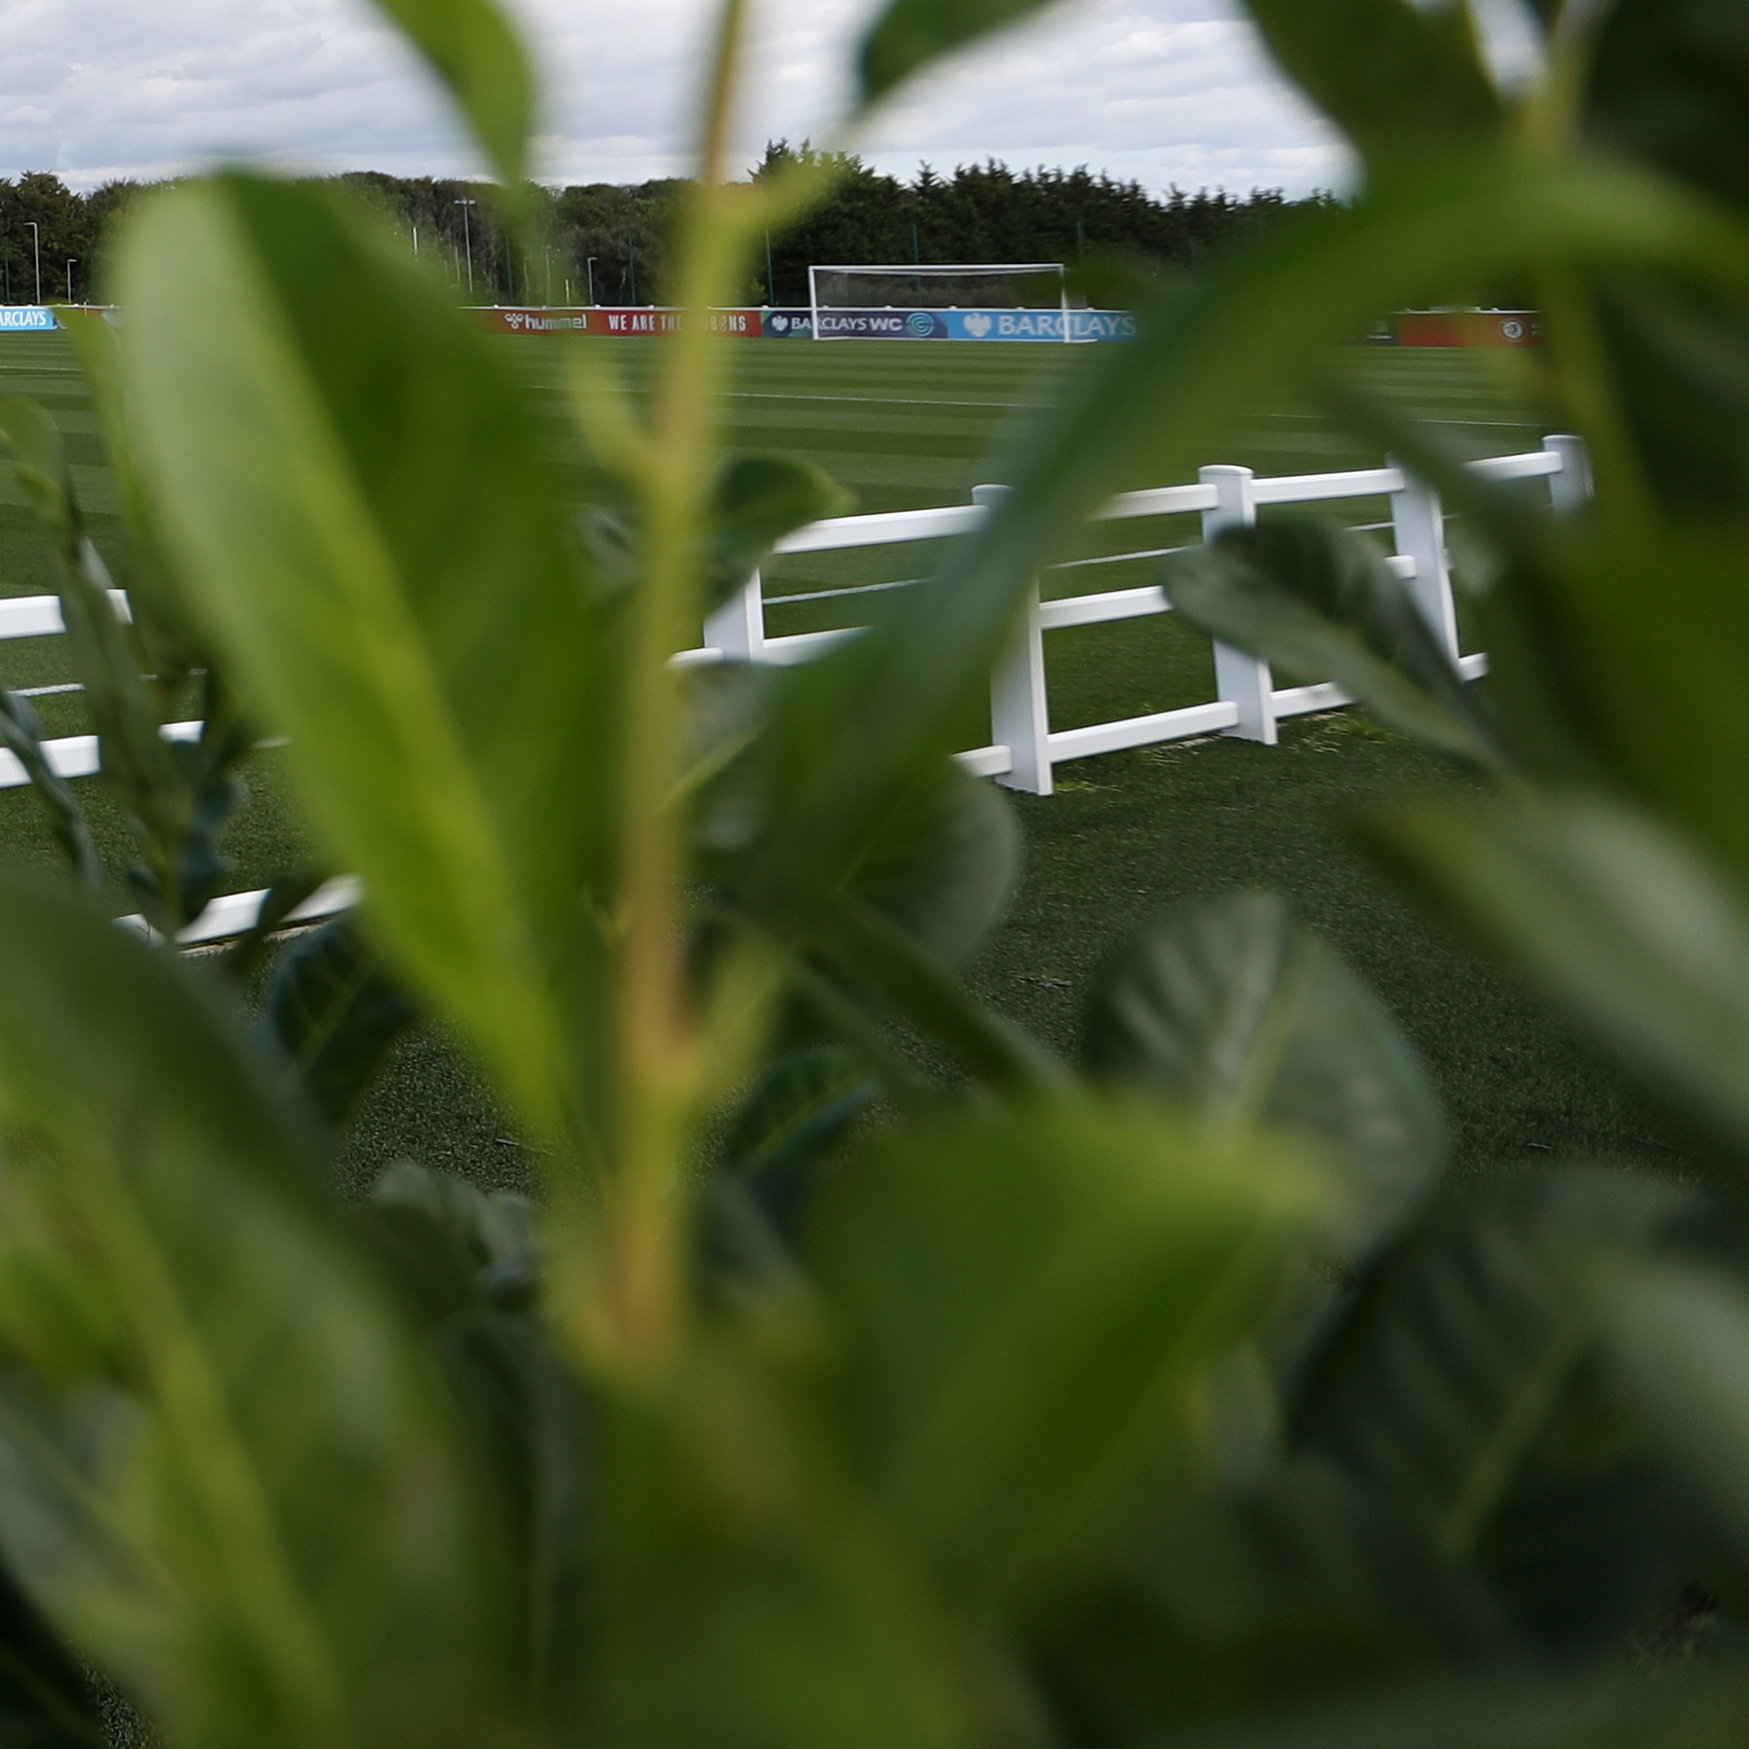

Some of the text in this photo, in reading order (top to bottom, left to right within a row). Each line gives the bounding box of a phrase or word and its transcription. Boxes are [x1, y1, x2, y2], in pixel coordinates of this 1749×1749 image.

[525, 314, 587, 330] hummel
[608, 315, 627, 331] WE
[632, 315, 654, 332] ARE
[869, 317, 903, 331] WC
[998, 315, 1136, 336] BARCLAYS
